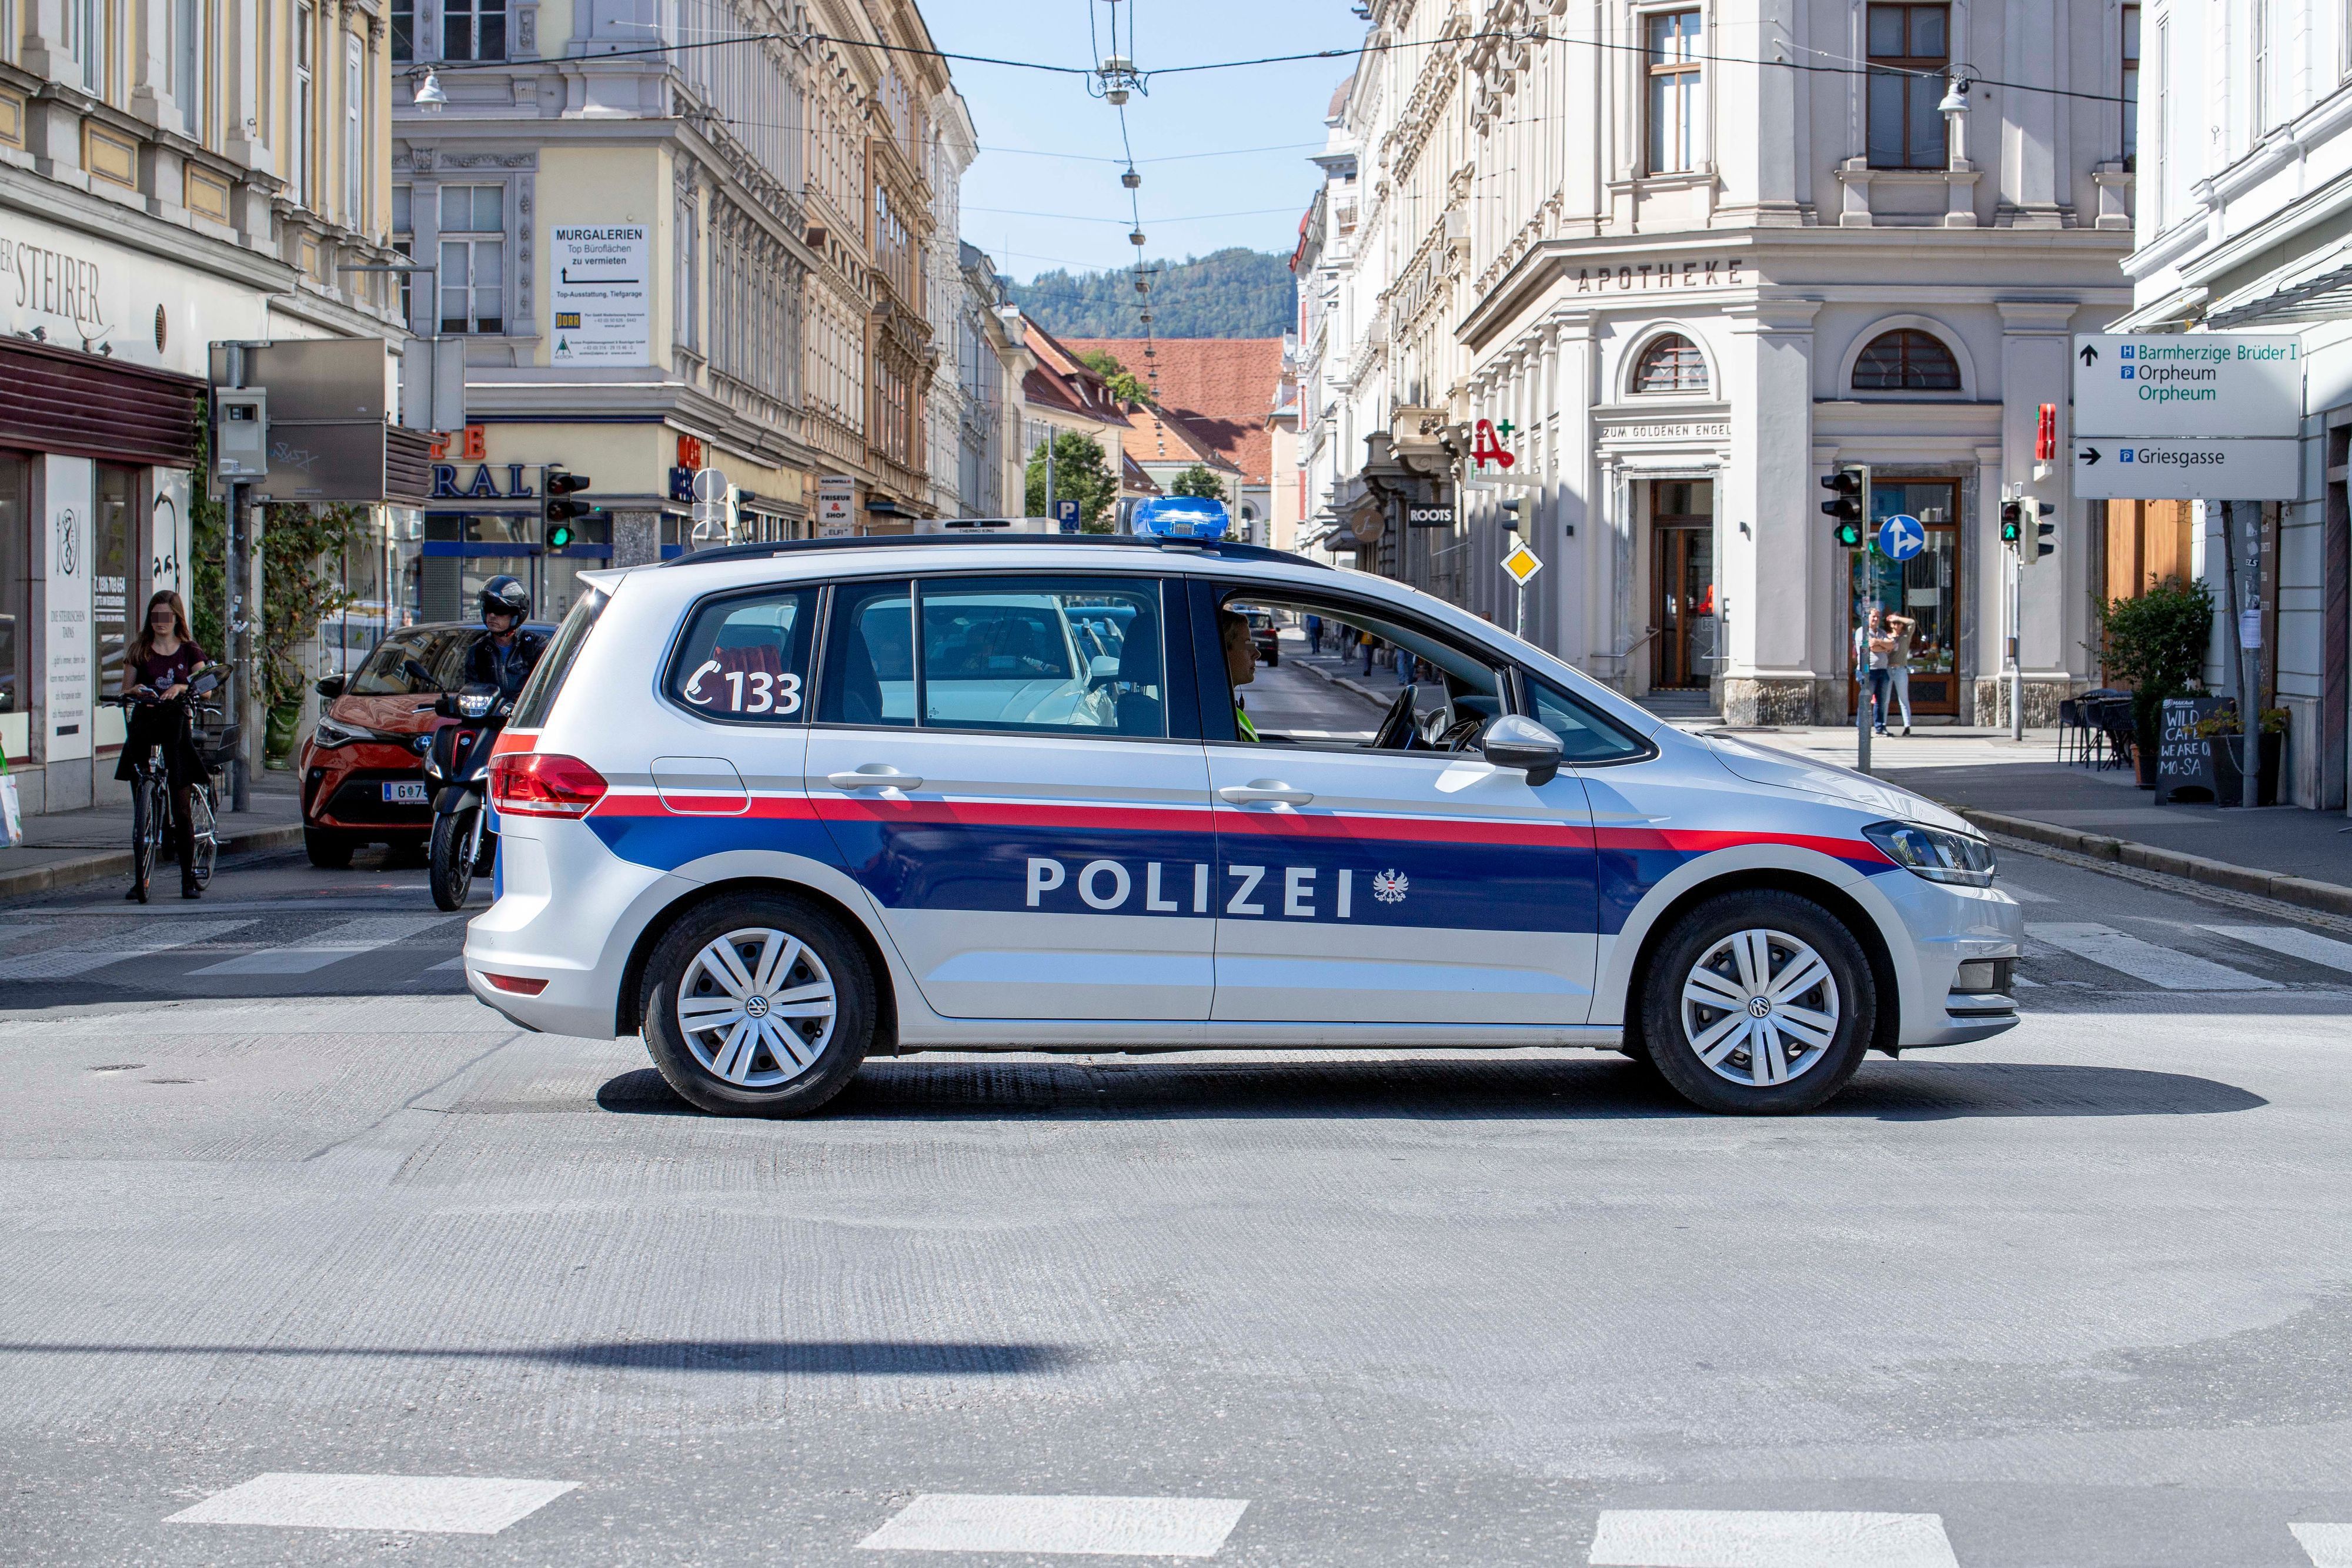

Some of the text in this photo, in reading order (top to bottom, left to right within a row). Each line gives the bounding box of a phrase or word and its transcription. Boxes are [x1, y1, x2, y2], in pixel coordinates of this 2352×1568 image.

[557, 229, 642, 240] MURGALERIEN
[568, 245, 632, 254] Top Büroflächen
[1578, 259, 1742, 292] APOTHEKE
[0, 238, 114, 340] ER STEIRER
[2139, 344, 2231, 364] Barmherzige
[2237, 345, 2286, 360] Brüder
[2139, 365, 2216, 384] Orpheum
[2139, 385, 2216, 404] Orpheum
[1602, 424, 1731, 437] ZUM GOLDENEN ENGEL
[2138, 447, 2225, 468] Griesgasse
[431, 463, 534, 499] RAL
[831, 502, 840, 511] &
[1410, 510, 1452, 521] ROOTS
[724, 670, 801, 714] 133
[2166, 710, 2200, 727] WILD
[2161, 744, 2175, 757] WE
[2177, 743, 2199, 757] ARE
[2160, 757, 2201, 776] MO-SA
[398, 785, 406, 798] G
[1026, 857, 1352, 918] POLIZEI
